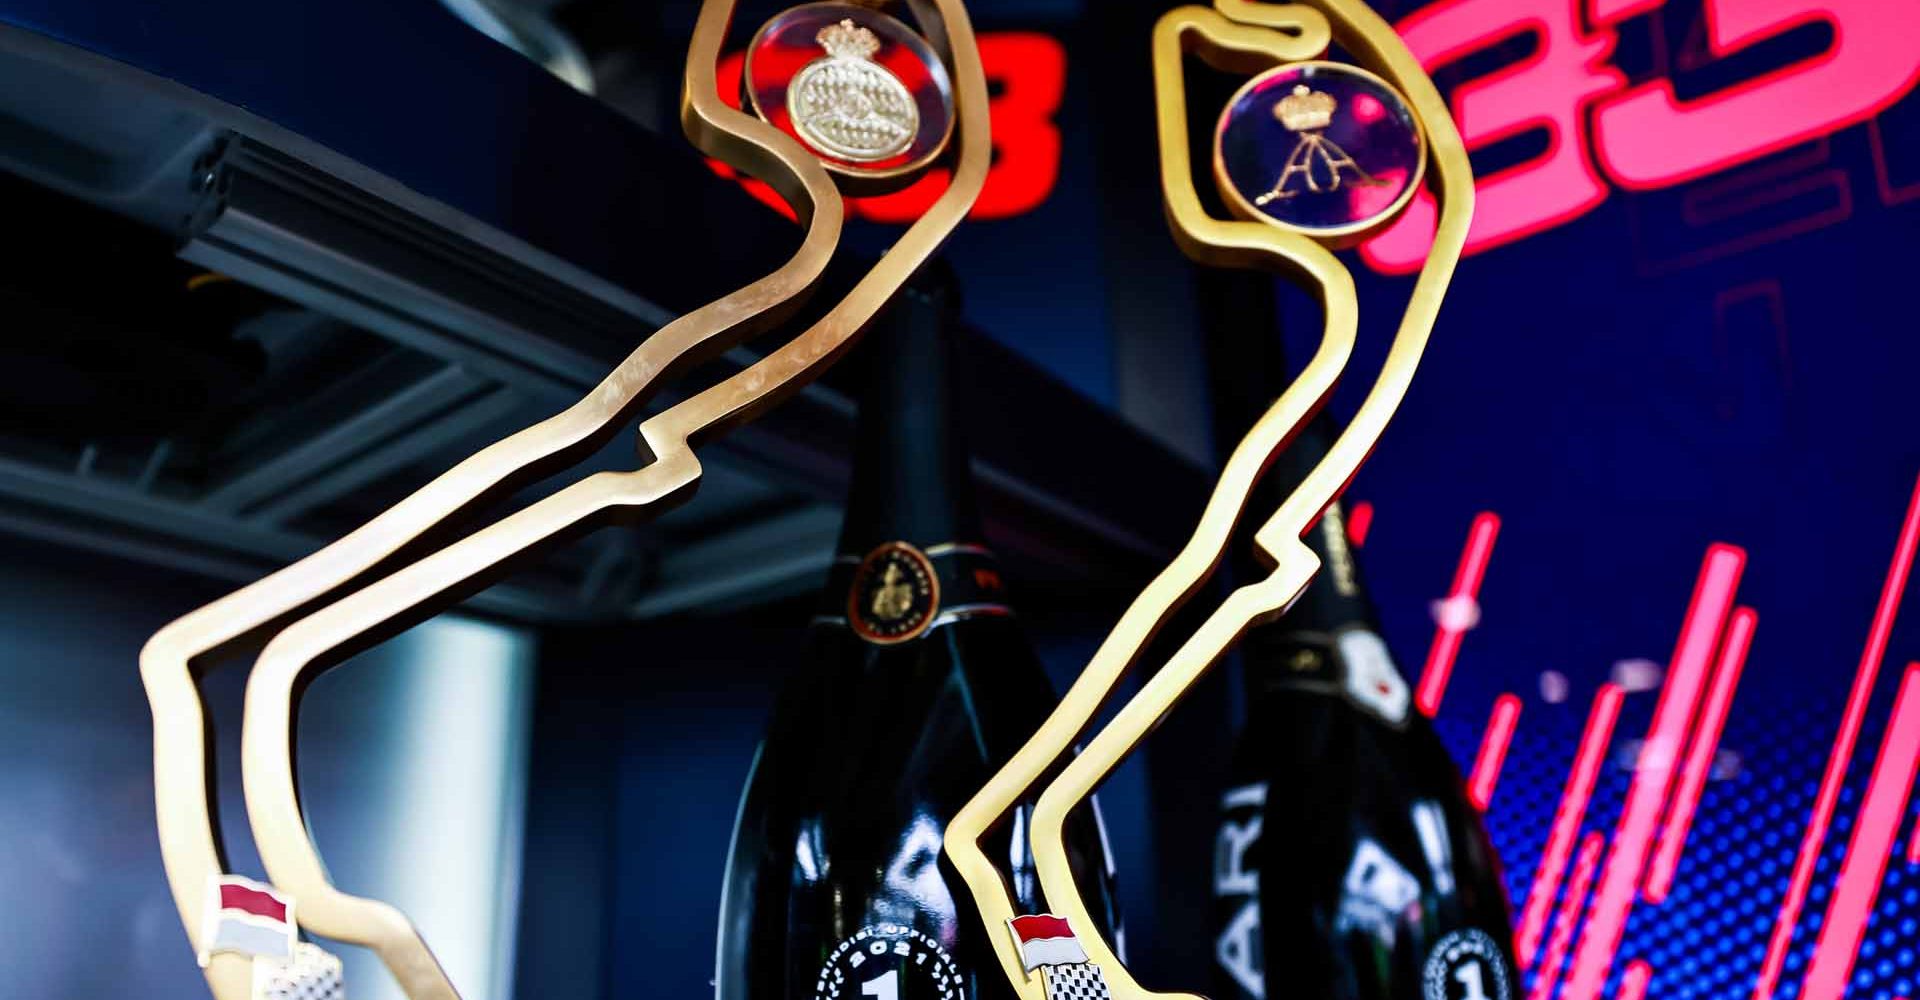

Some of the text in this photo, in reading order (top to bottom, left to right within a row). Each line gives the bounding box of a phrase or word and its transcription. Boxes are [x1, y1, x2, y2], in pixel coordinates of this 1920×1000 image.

[849, 940, 927, 968] 2021
[887, 924, 963, 984] UFFICIALE
[1455, 960, 1493, 1000] 1
